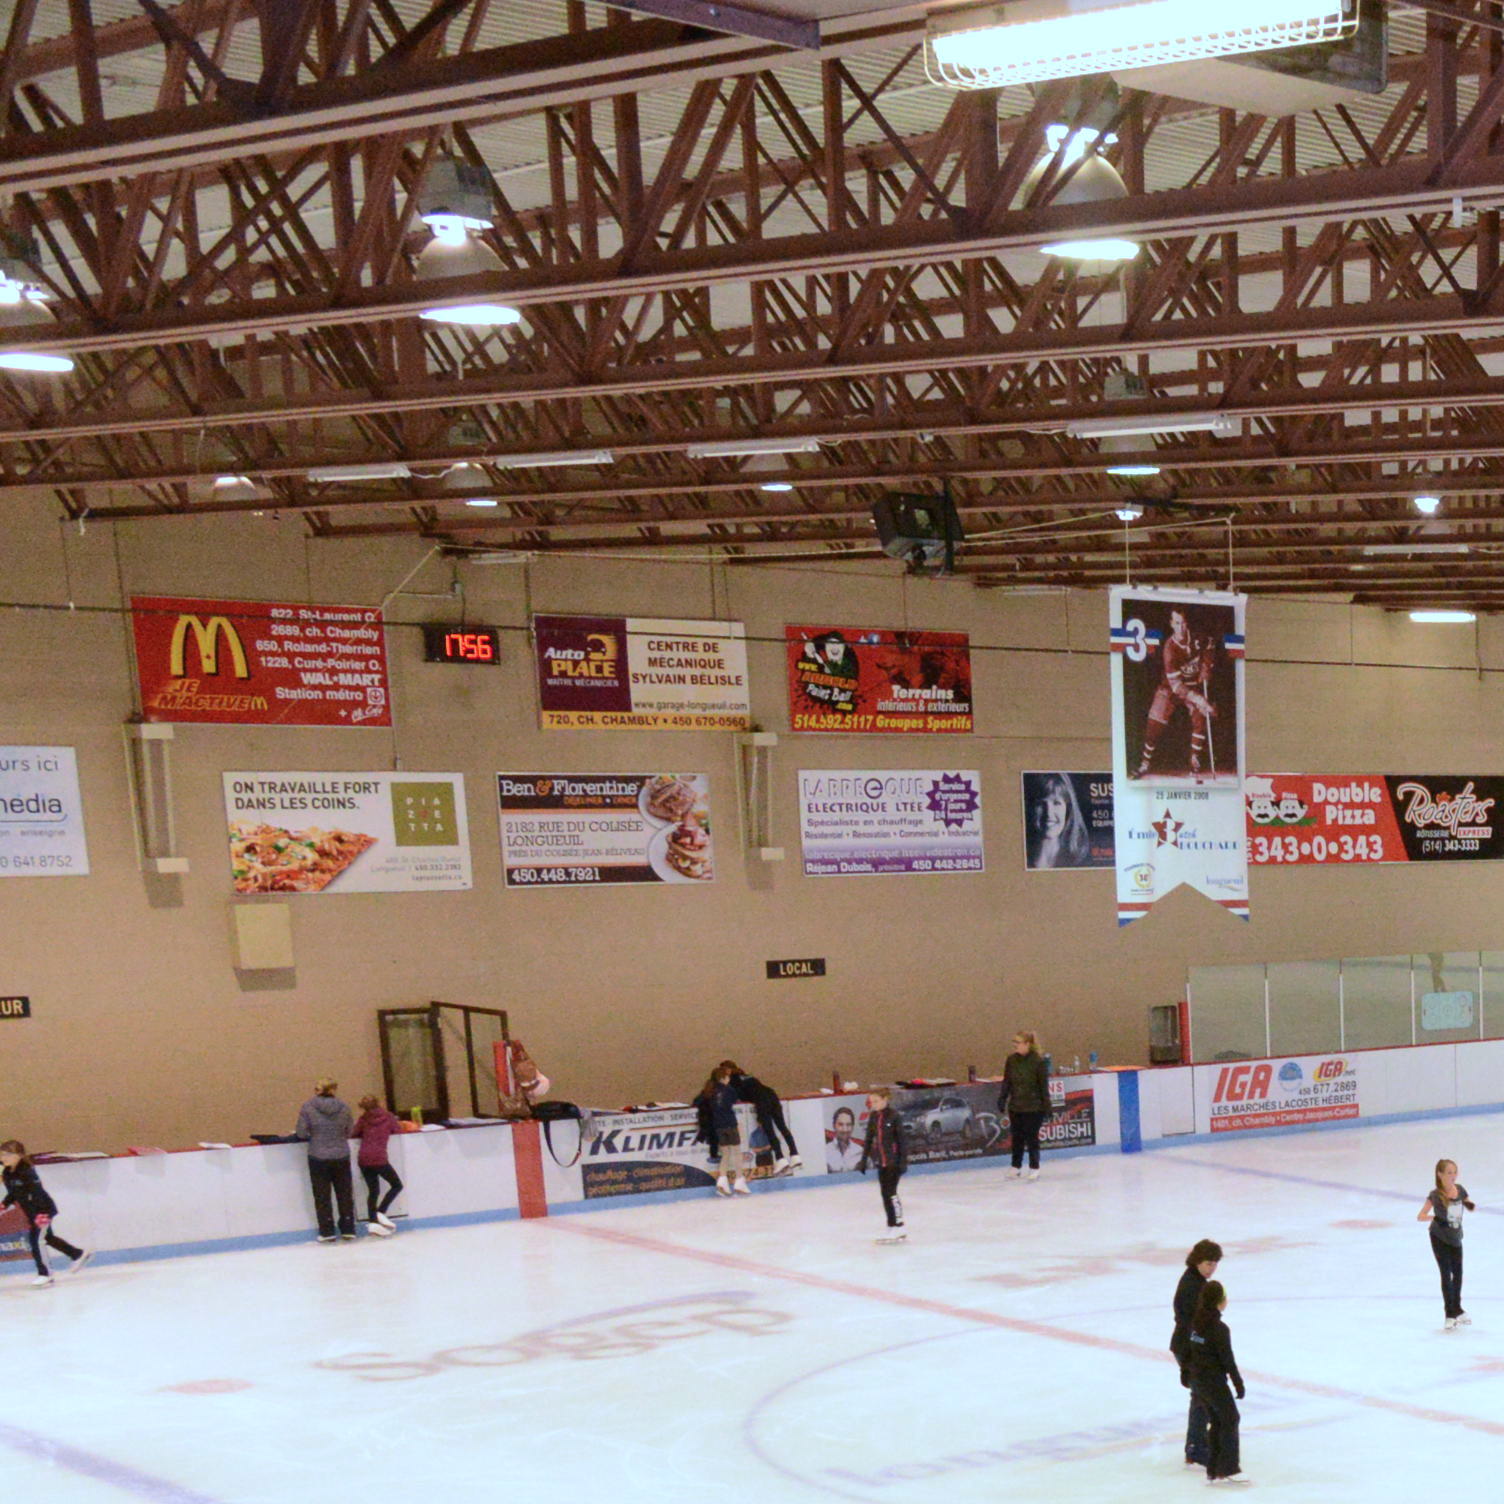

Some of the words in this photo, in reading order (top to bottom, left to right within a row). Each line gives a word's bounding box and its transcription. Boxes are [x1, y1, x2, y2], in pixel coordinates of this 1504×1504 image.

[327, 626, 379, 640] Chambly
[1126, 618, 1147, 662] 3
[284, 640, 380, 655] Roland-Therrien
[544, 647, 585, 660] Auto
[647, 641, 699, 653] CENTRE
[702, 642, 719, 653] DE
[294, 656, 365, 670] Curé-Poirier
[552, 660, 616, 678] PLACE
[648, 655, 725, 670] MÉCANIQUE
[632, 672, 686, 685] SYLVAIN
[691, 672, 743, 687] BÉLISLE
[275, 687, 322, 701] Station
[326, 687, 363, 701] métro
[892, 684, 954, 700] Terrains
[877, 699, 917, 712] intérieurs
[927, 700, 970, 713] extérieurs
[578, 714, 598, 726] CH.
[601, 715, 659, 727] CHAMBLY
[671, 716, 692, 727] 450
[876, 715, 924, 731] Groupes
[927, 714, 972, 731] Sportifs
[36, 754, 59, 772] ici
[233, 781, 254, 794] ON
[258, 781, 340, 794] TRAVAILLE
[343, 781, 381, 794] FORT
[501, 779, 536, 796] Ben
[536, 779, 552, 797] &
[552, 780, 638, 796] Florentine
[1312, 782, 1382, 804] Double
[235, 797, 277, 810] DANS
[281, 797, 308, 810] LES
[311, 797, 360, 810] COINS.
[863, 819, 875, 827] en
[877, 817, 924, 827] chauffage
[1325, 805, 1376, 825] Pizza
[506, 820, 535, 833] 2182
[539, 820, 569, 833] RUE
[571, 820, 586, 833] DU
[589, 819, 644, 833] COLISÉE
[1458, 828, 1492, 837] EXPRESS
[506, 834, 584, 847] LONGUEUIL
[912, 859, 932, 871] 450
[511, 866, 600, 882] 450.448.7921
[780, 962, 814, 975] LOCAL
[1318, 1060, 1344, 1079] IGA
[1213, 1064, 1273, 1103] IGA
[1212, 1105, 1230, 1116] LES
[1279, 1096, 1320, 1110] LACOSTE
[612, 1113, 665, 1127] INSTALLATION
